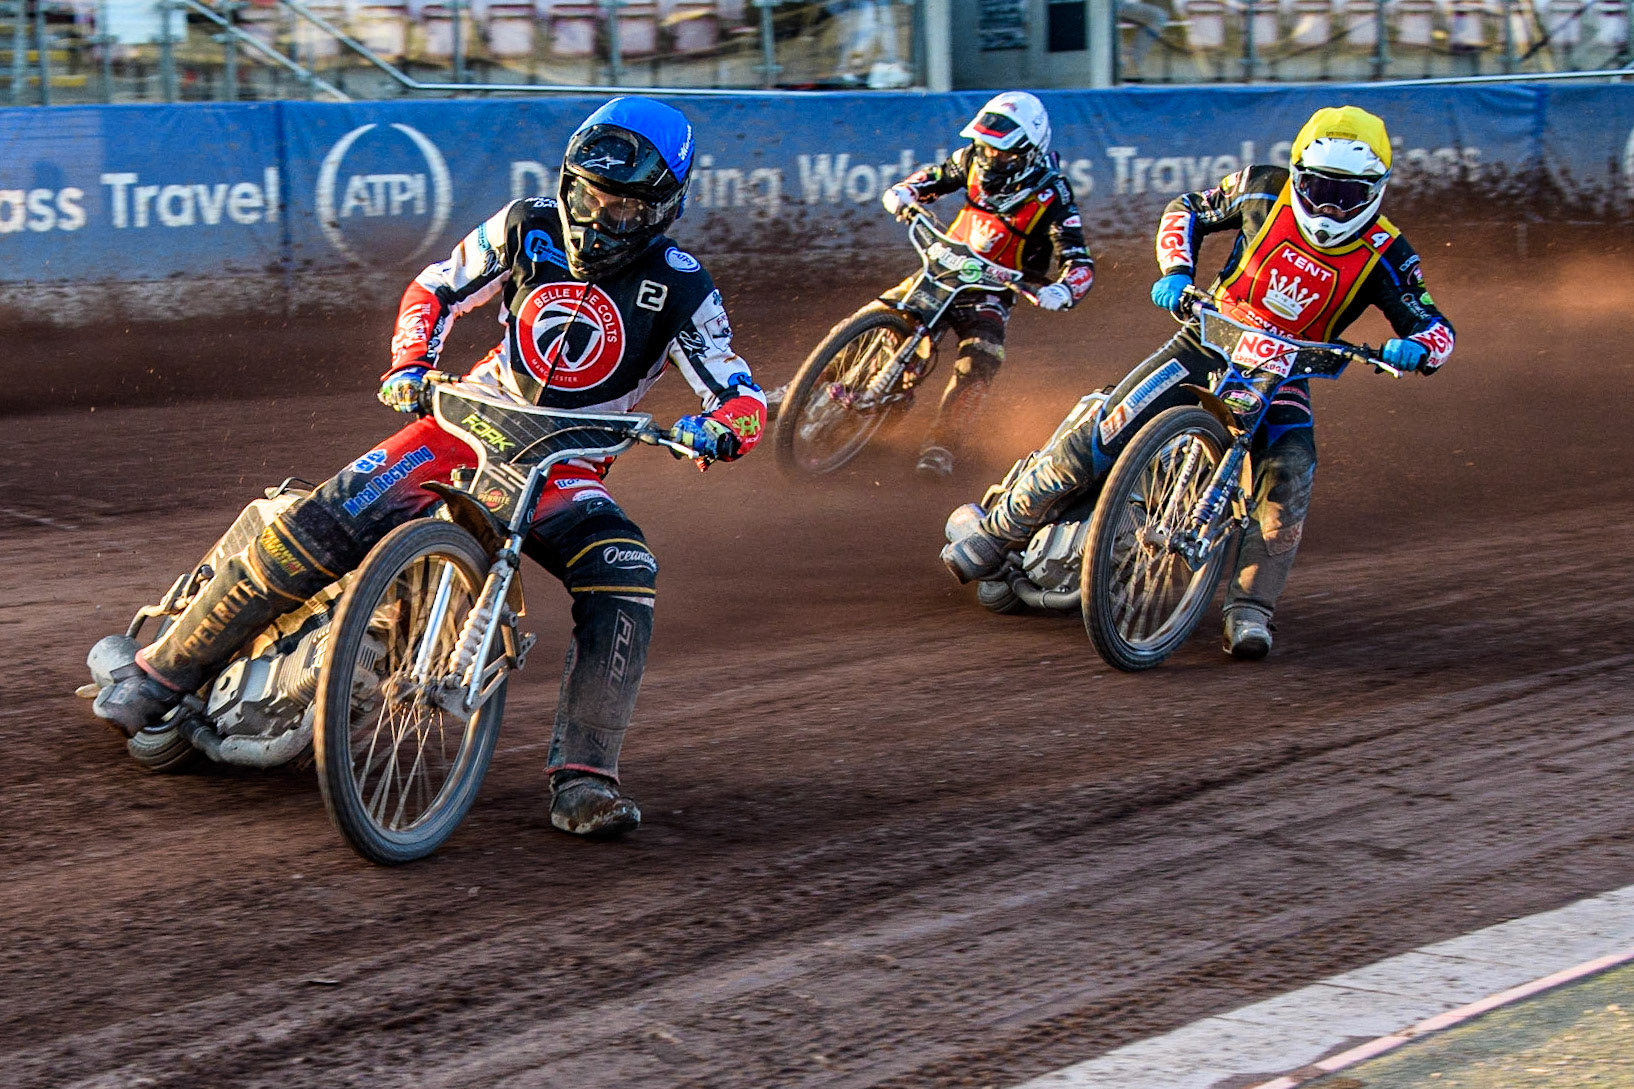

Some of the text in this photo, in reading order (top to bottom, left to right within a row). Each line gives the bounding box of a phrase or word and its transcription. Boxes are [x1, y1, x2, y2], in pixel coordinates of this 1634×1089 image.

[101, 167, 280, 229] Travel
[339, 173, 428, 217] ATPI
[1161, 214, 1190, 264] NGK
[1371, 232, 1391, 248] 4
[1281, 248, 1332, 282] KENT
[534, 288, 570, 308] BELLE
[598, 304, 618, 343] COLTS
[1246, 310, 1294, 340] ROYALS
[532, 358, 578, 382] MANCESTER
[1237, 335, 1295, 367] NGK
[1262, 361, 1287, 375] LUGS
[461, 413, 516, 452] FORK
[342, 445, 436, 518] Metal Recycling
[183, 578, 255, 648] PENRITE
